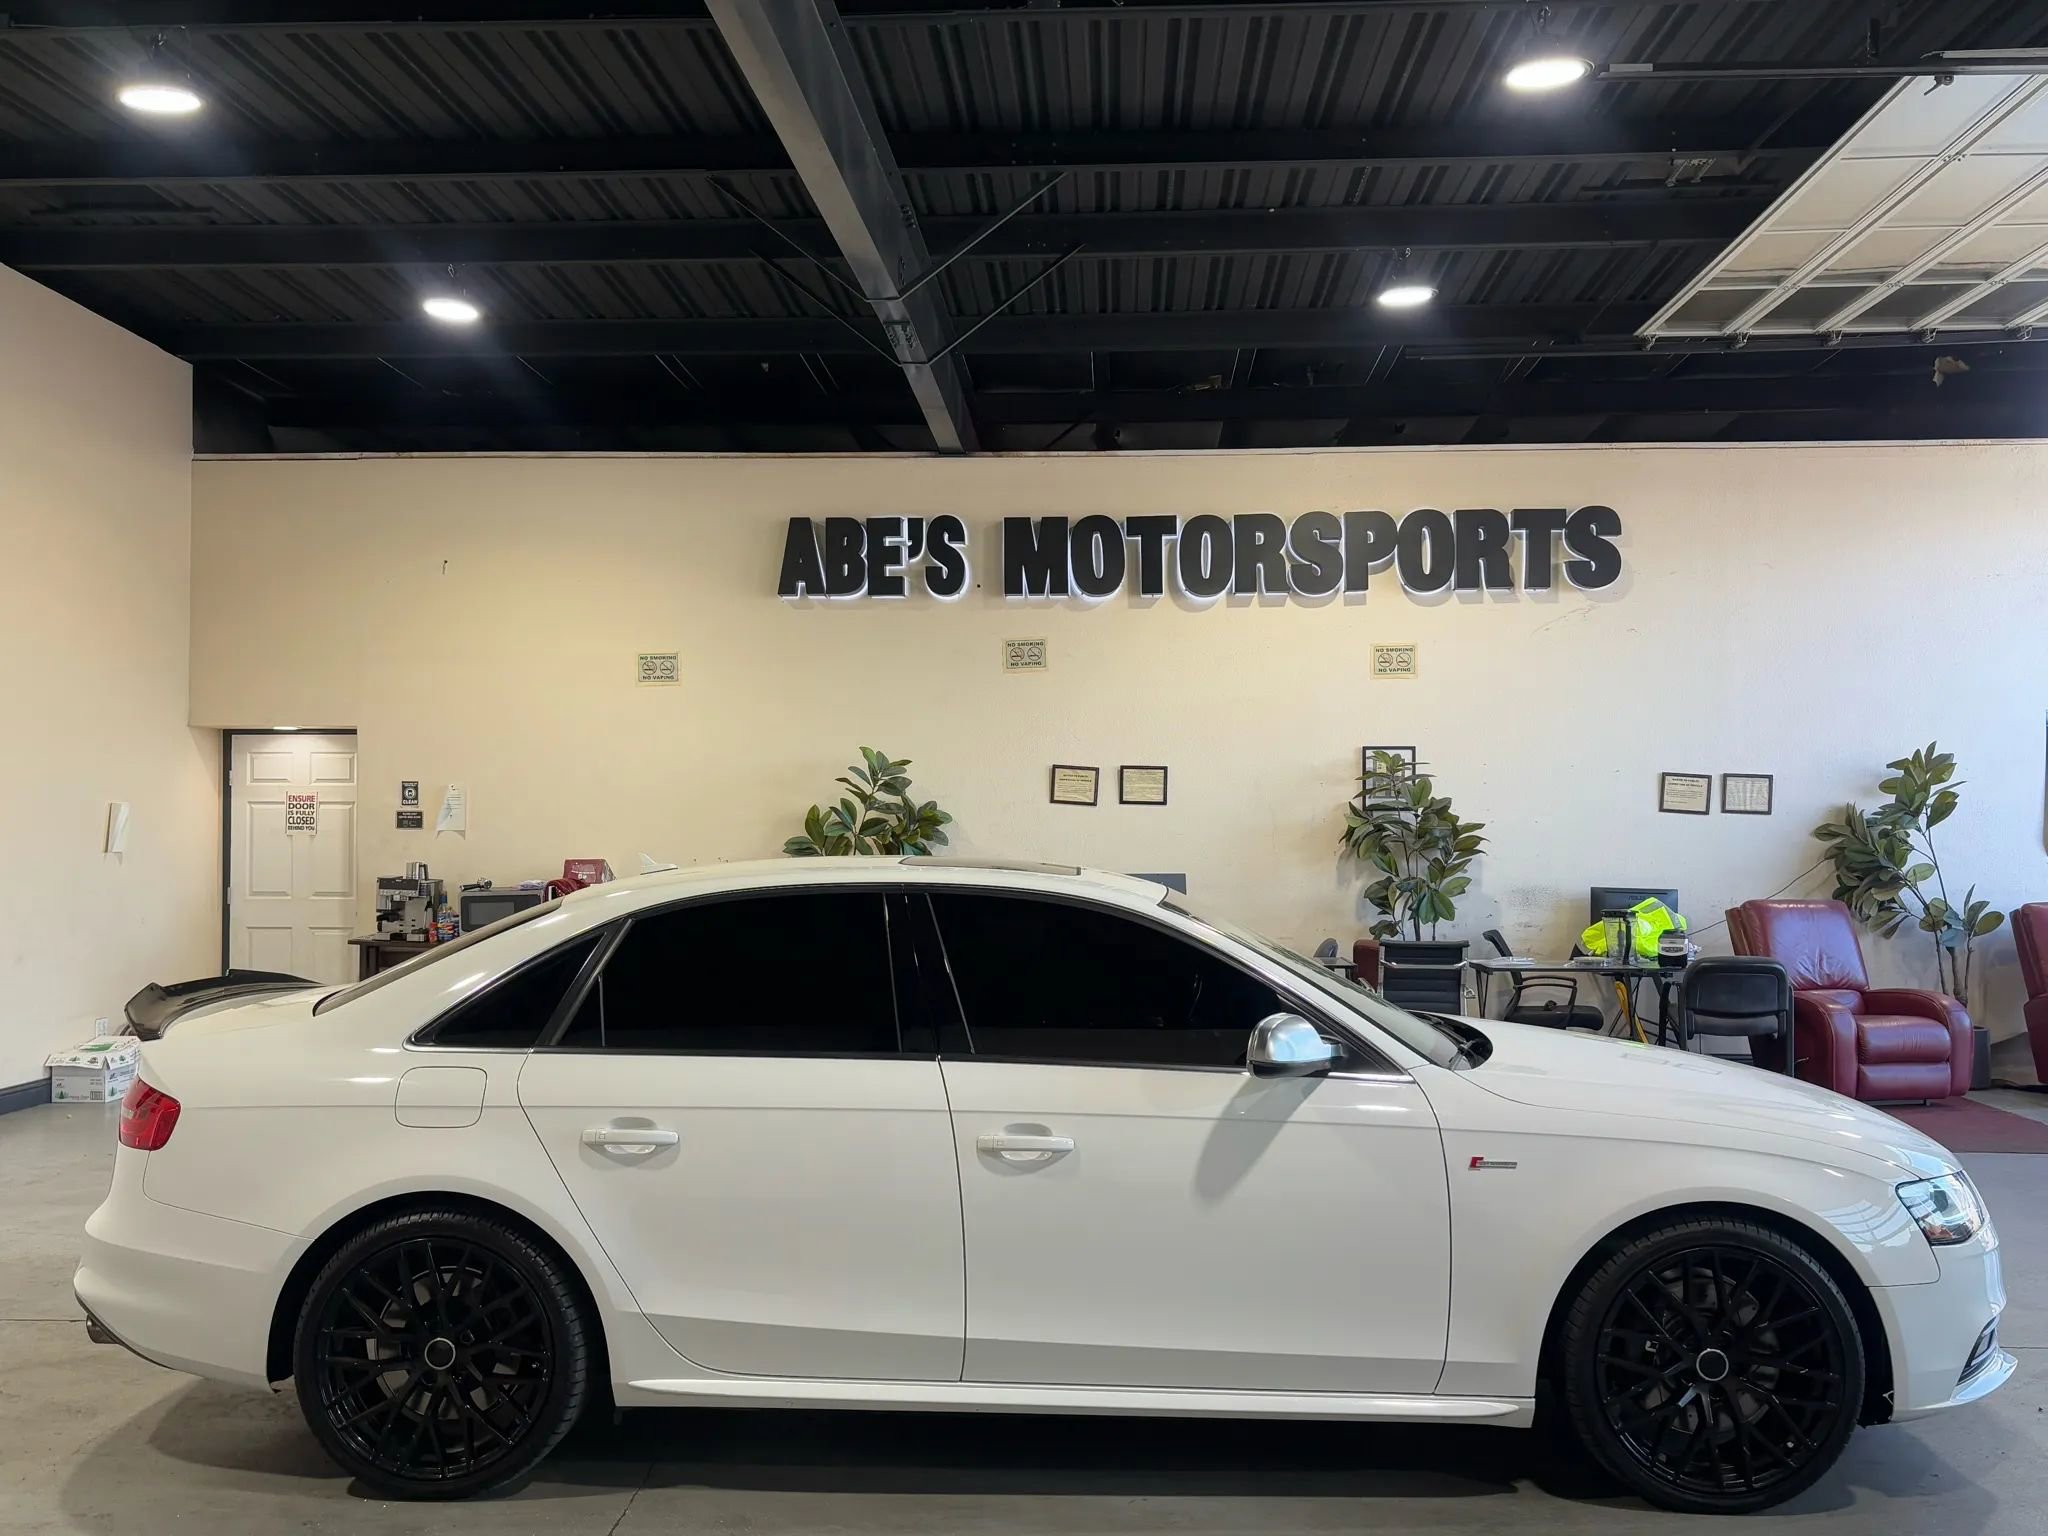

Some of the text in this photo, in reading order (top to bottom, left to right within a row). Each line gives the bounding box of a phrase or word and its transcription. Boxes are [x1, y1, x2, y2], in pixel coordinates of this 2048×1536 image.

[778, 506, 1622, 600] ABE'S MOTORSPORTS
[288, 794, 316, 802] ENSURE
[288, 802, 315, 810] DOOR
[287, 815, 315, 825] CLOSED
